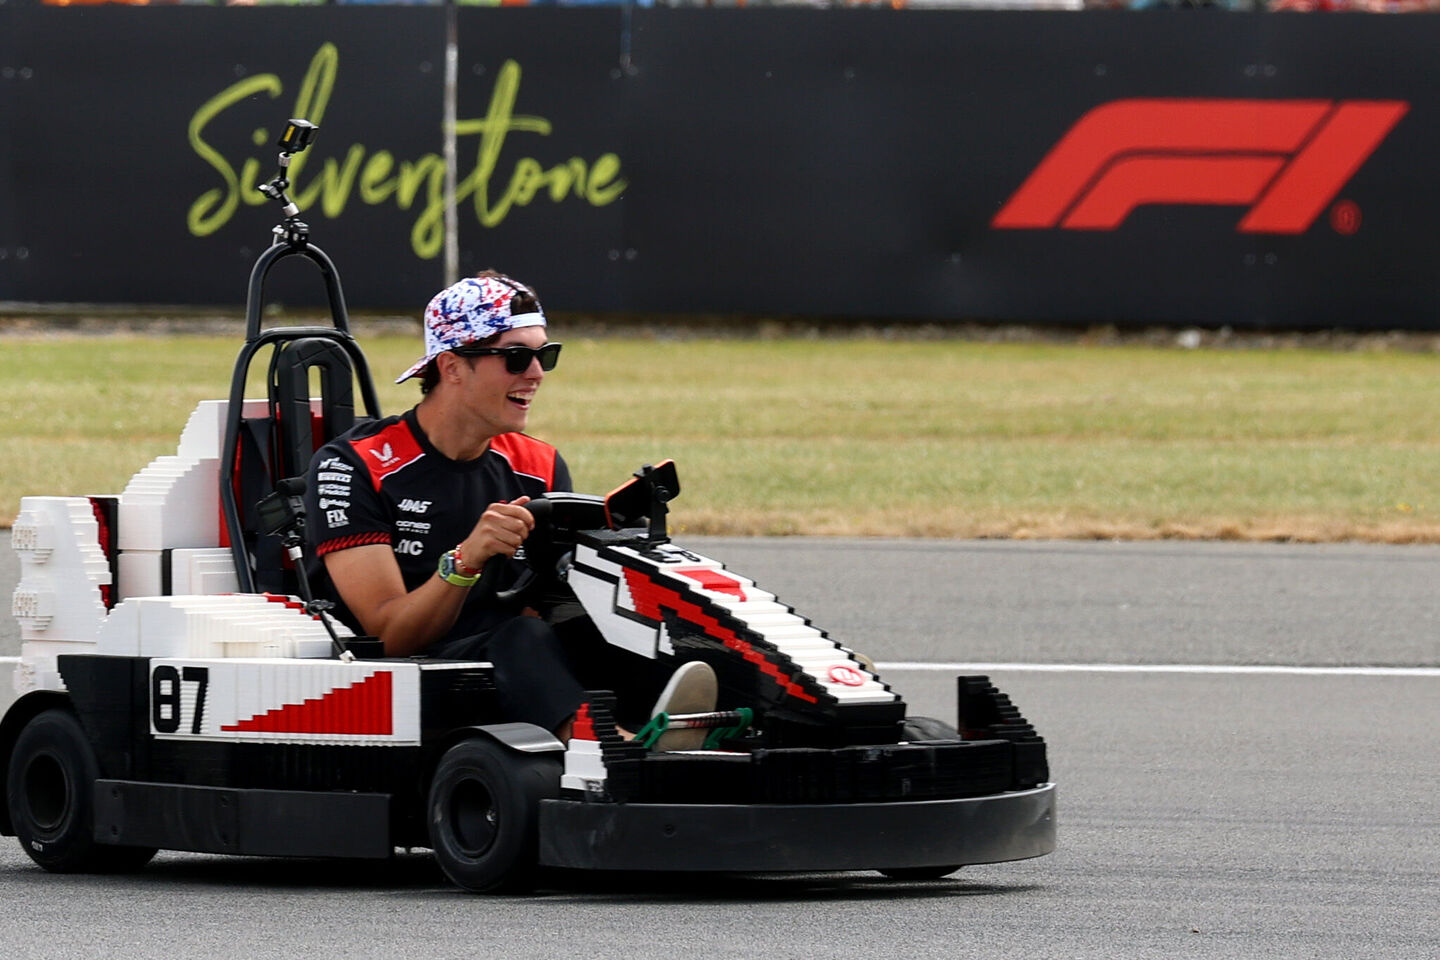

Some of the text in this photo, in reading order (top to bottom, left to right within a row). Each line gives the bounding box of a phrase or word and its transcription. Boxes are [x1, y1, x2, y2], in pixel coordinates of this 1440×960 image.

[187, 42, 627, 260] Silverstone
[326, 509, 349, 524] FIX
[152, 665, 209, 735] 87
